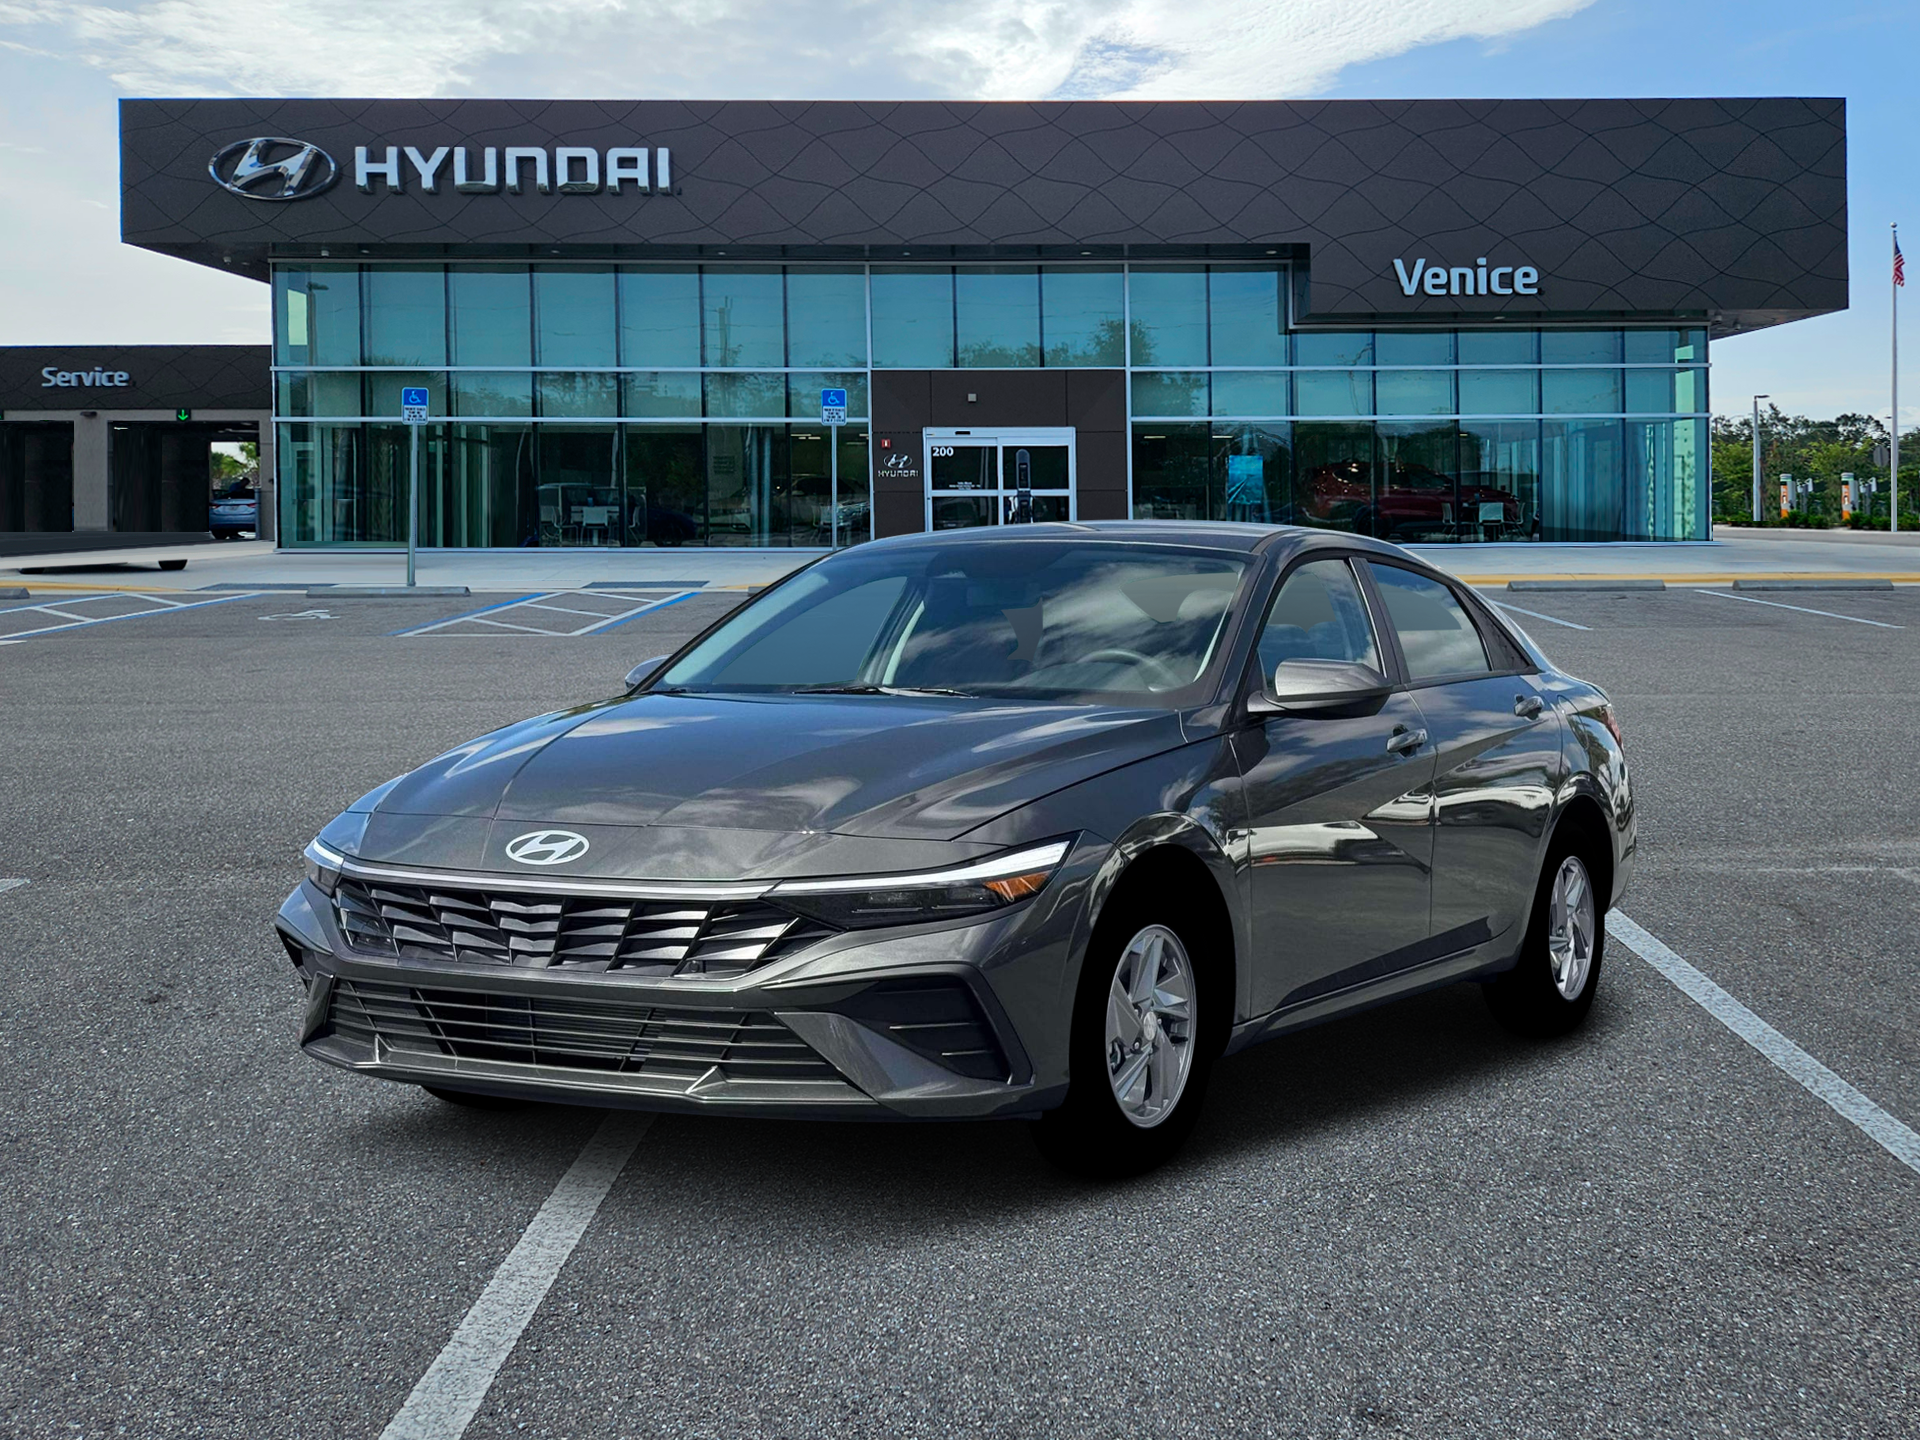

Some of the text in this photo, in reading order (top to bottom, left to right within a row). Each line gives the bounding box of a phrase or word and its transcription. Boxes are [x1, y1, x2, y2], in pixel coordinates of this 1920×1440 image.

[354, 146, 670, 194] HYUNDAI
[1393, 257, 1539, 296] Venice
[41, 366, 130, 387] Service
[932, 446, 954, 457] 200
[877, 469, 919, 478] HYUNDAI
